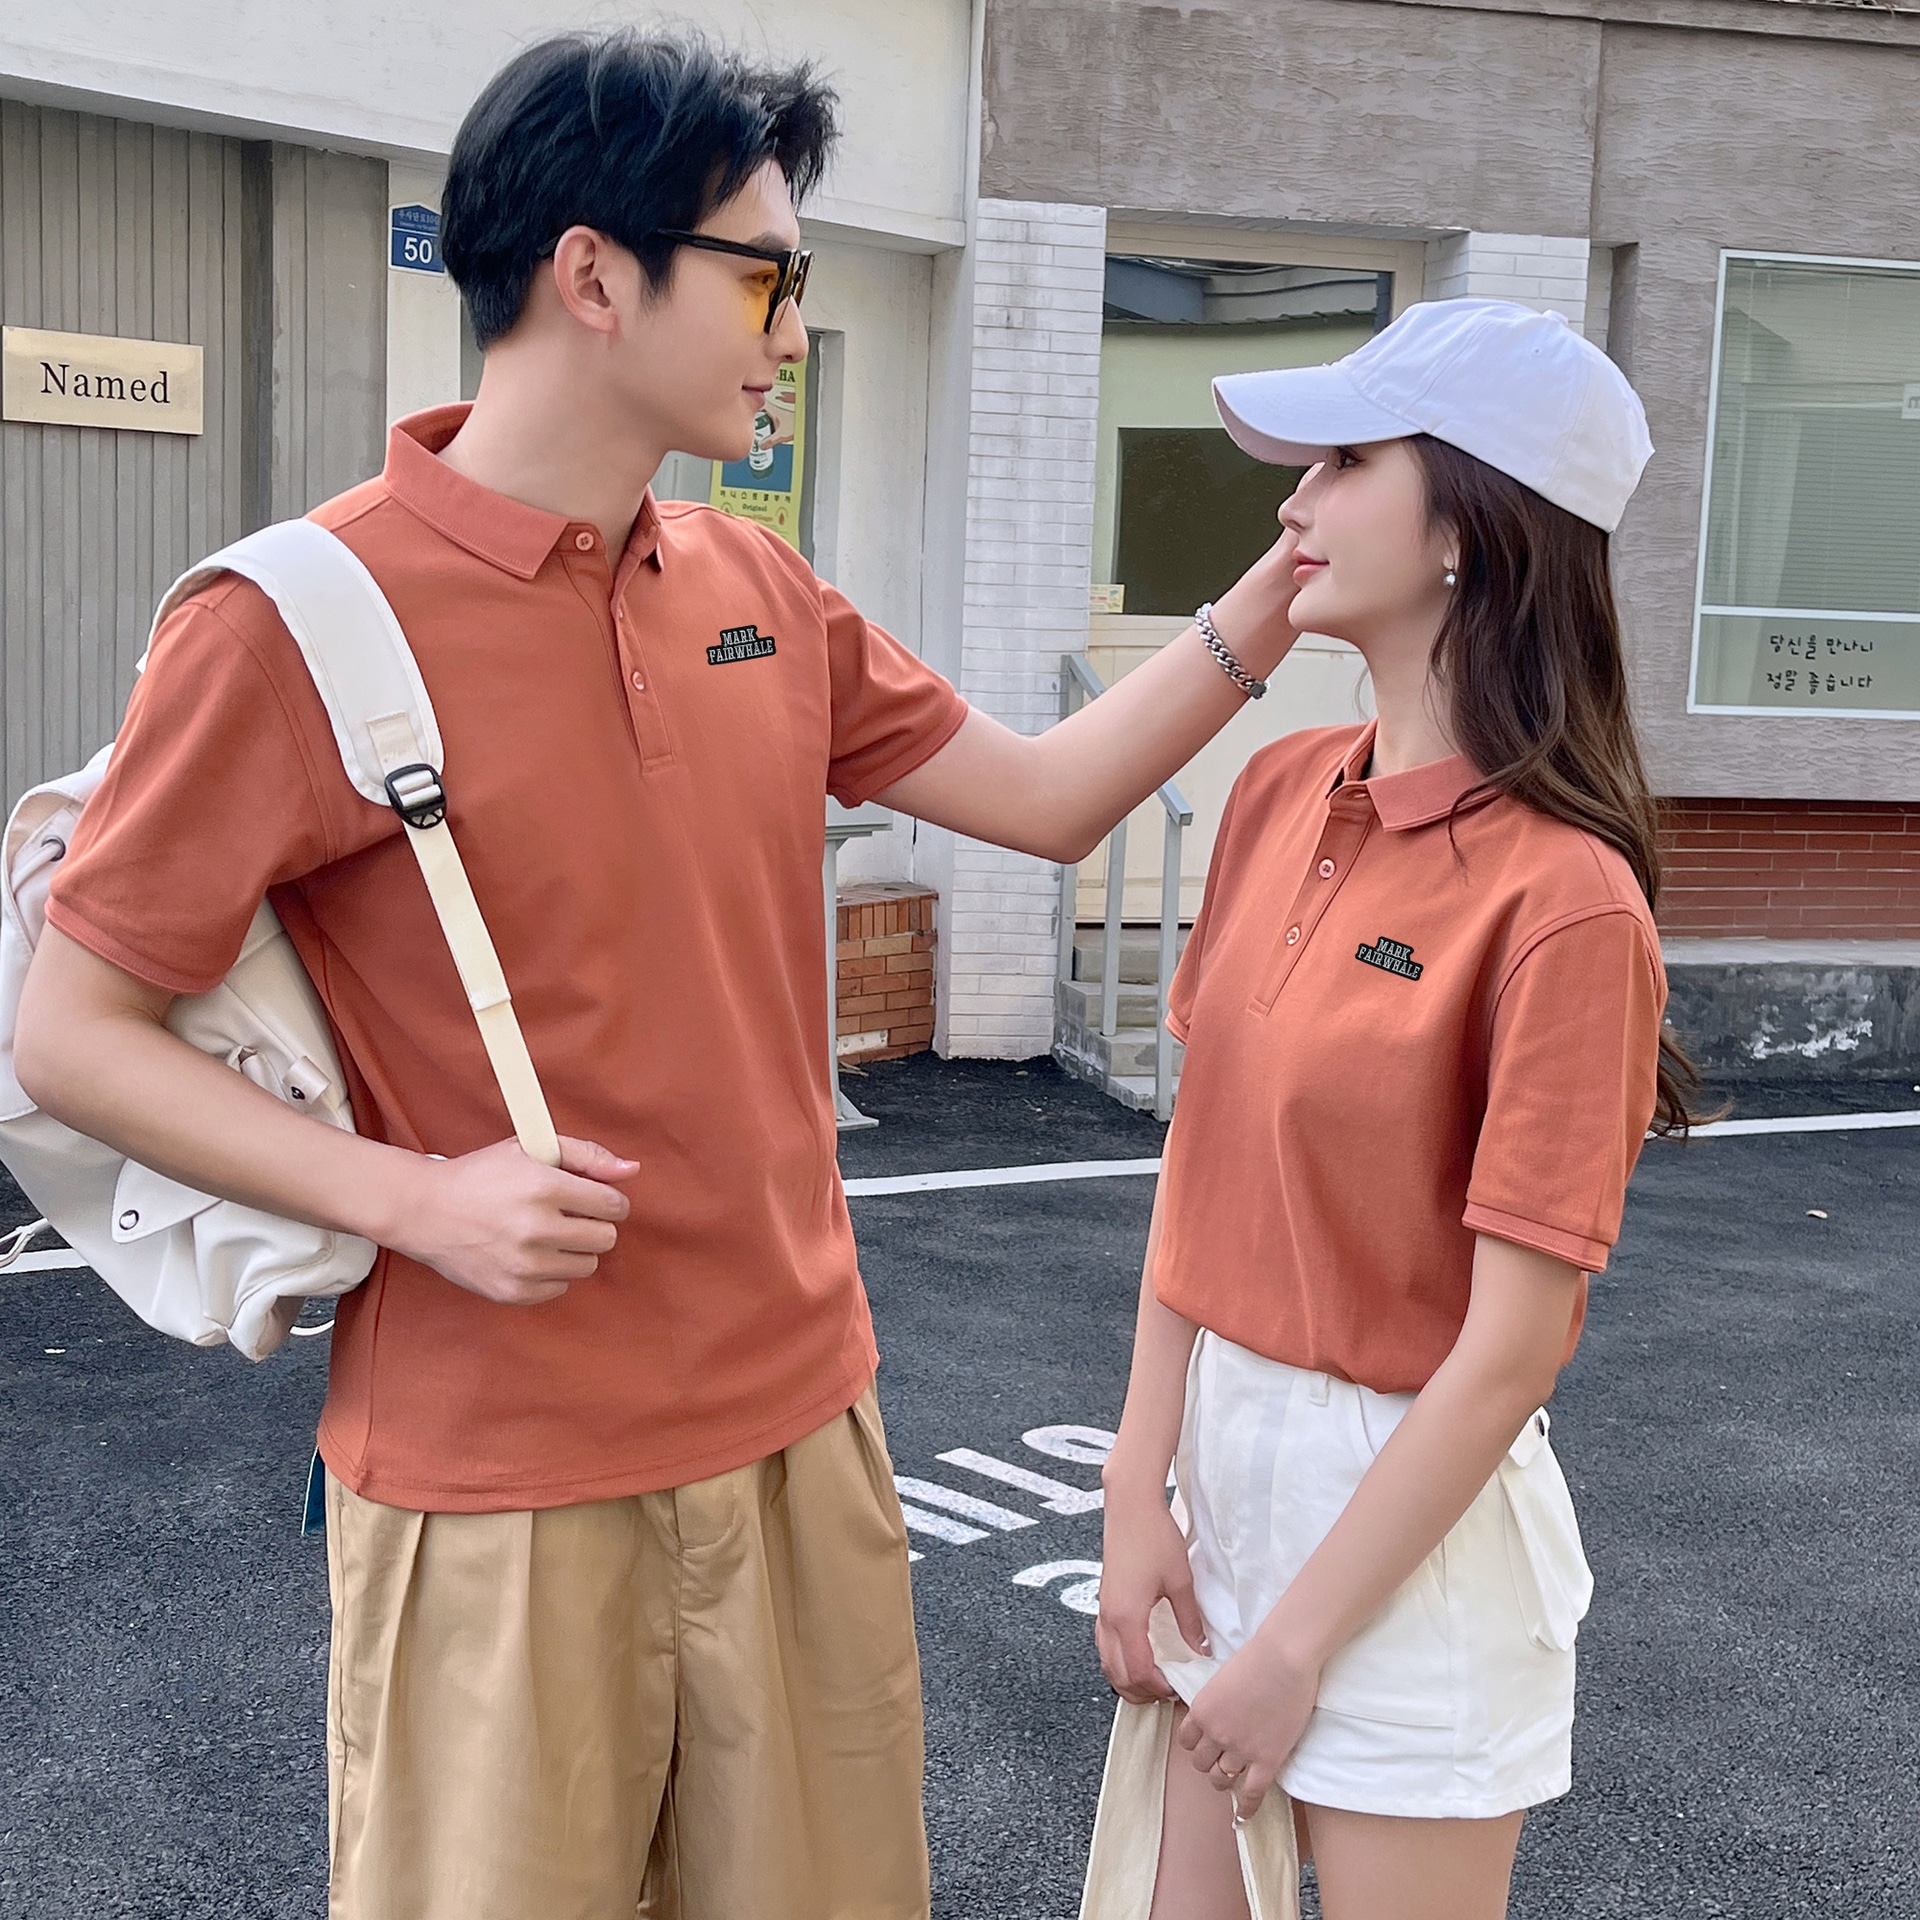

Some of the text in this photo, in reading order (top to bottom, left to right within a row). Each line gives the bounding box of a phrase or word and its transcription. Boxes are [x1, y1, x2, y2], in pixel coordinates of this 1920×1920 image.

[404, 236, 433, 264] 50
[40, 361, 171, 404] Named
[776, 369, 796, 383] HA
[722, 628, 756, 647] MARK
[1770, 634, 1873, 660] 당신을 만나니
[709, 640, 774, 663] FAIRWHALE
[1766, 669, 1873, 695] 정말 좋습니다
[1357, 946, 1421, 979] FAIRWHALE
[1376, 938, 1411, 961] MARK
